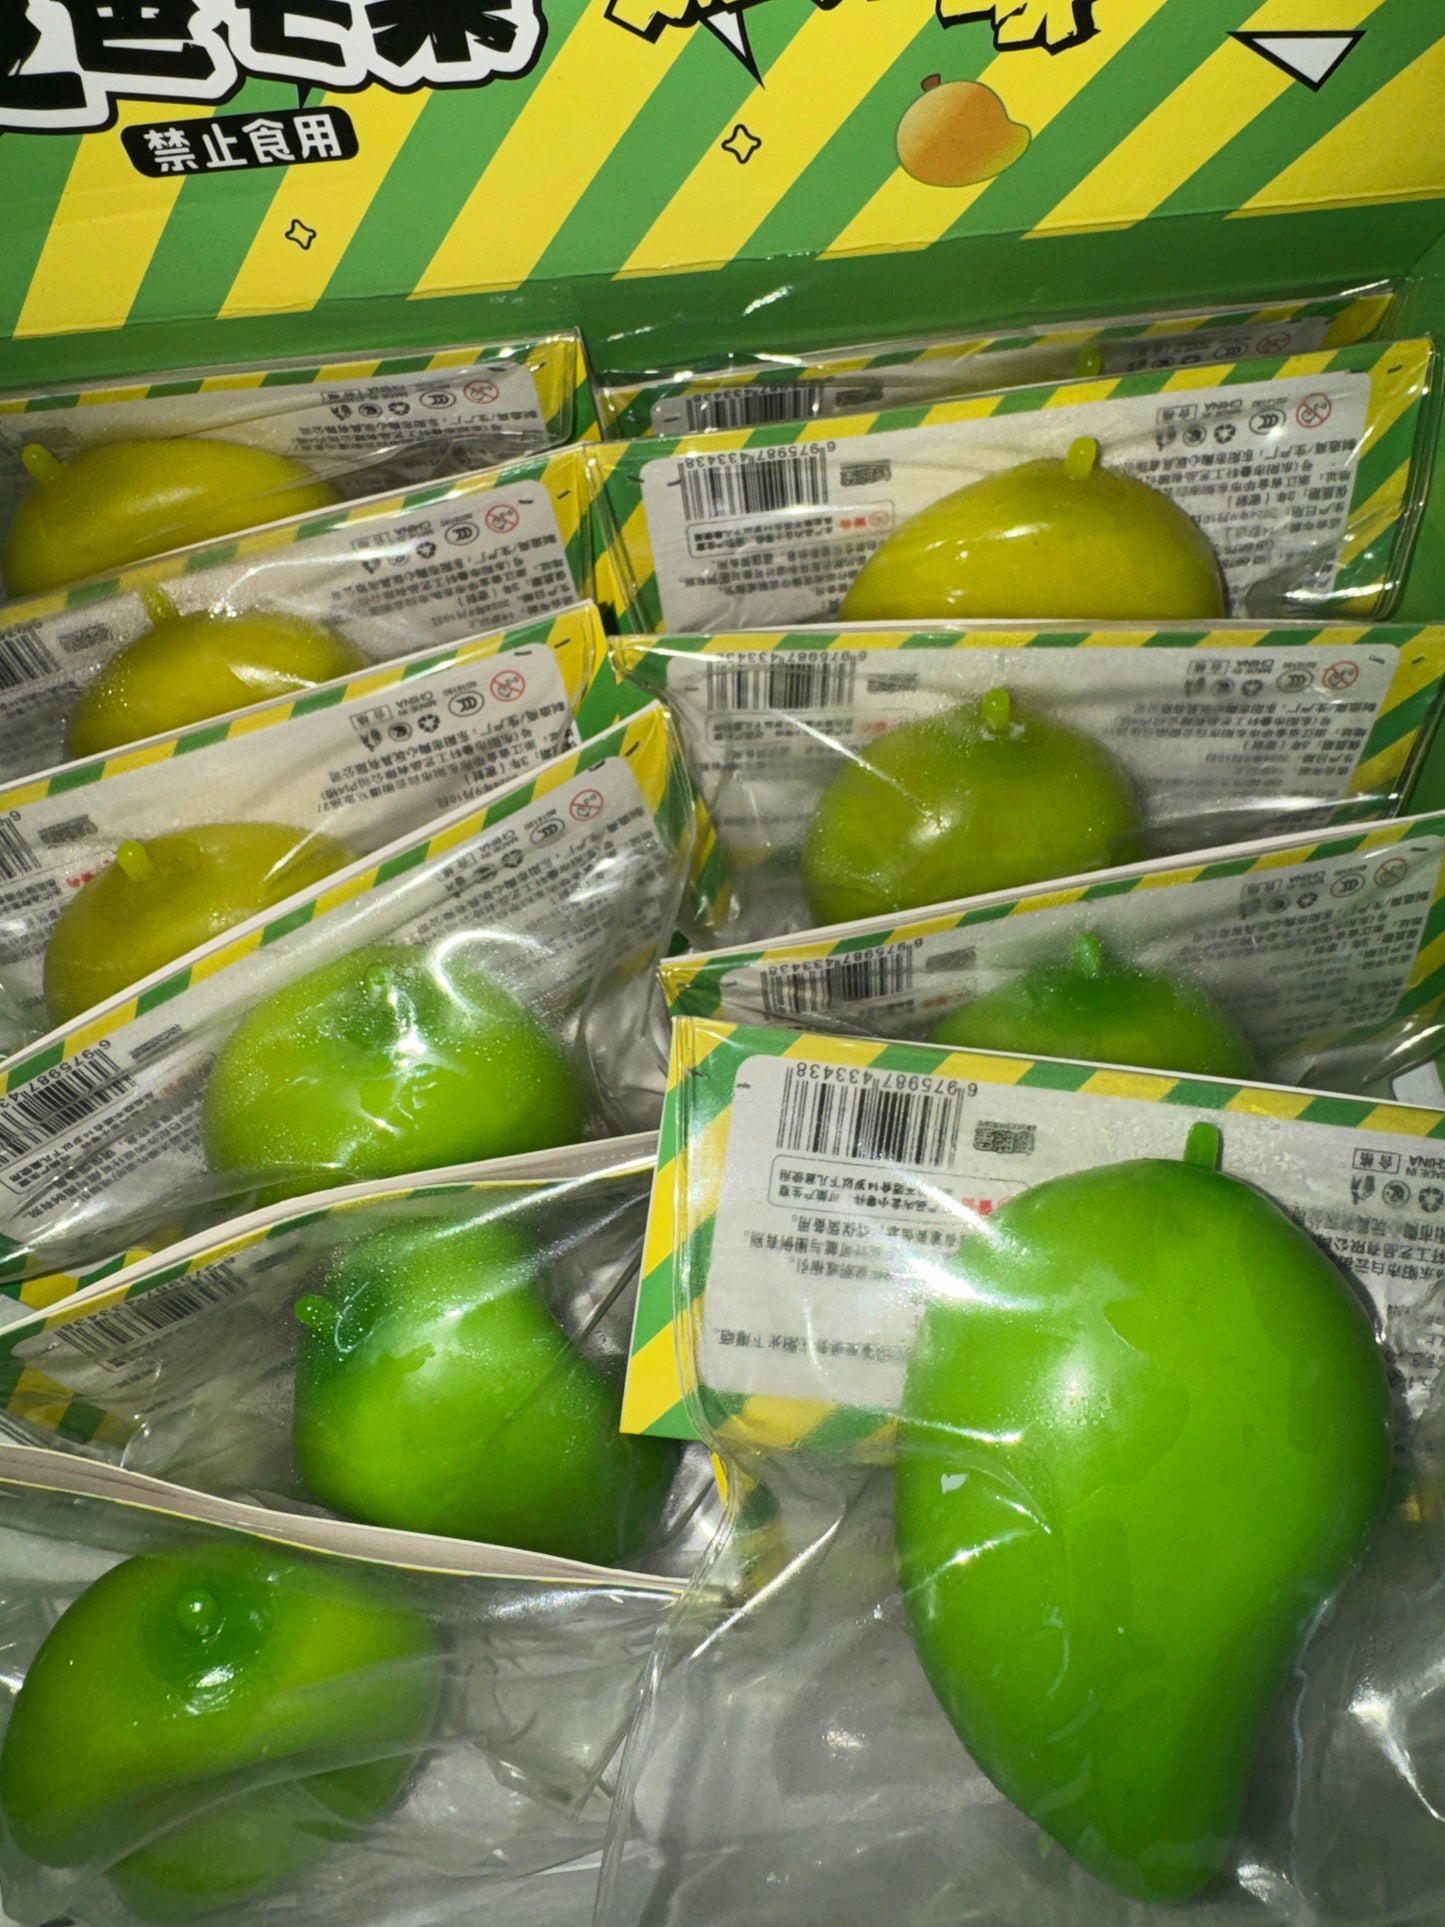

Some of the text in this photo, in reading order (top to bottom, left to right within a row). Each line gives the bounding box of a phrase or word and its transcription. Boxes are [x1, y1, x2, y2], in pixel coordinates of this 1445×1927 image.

[142, 113, 343, 173] 禁止食用
[28, 1049, 95, 1094] 975987
[794, 1061, 977, 1097] 6 975987 433438
